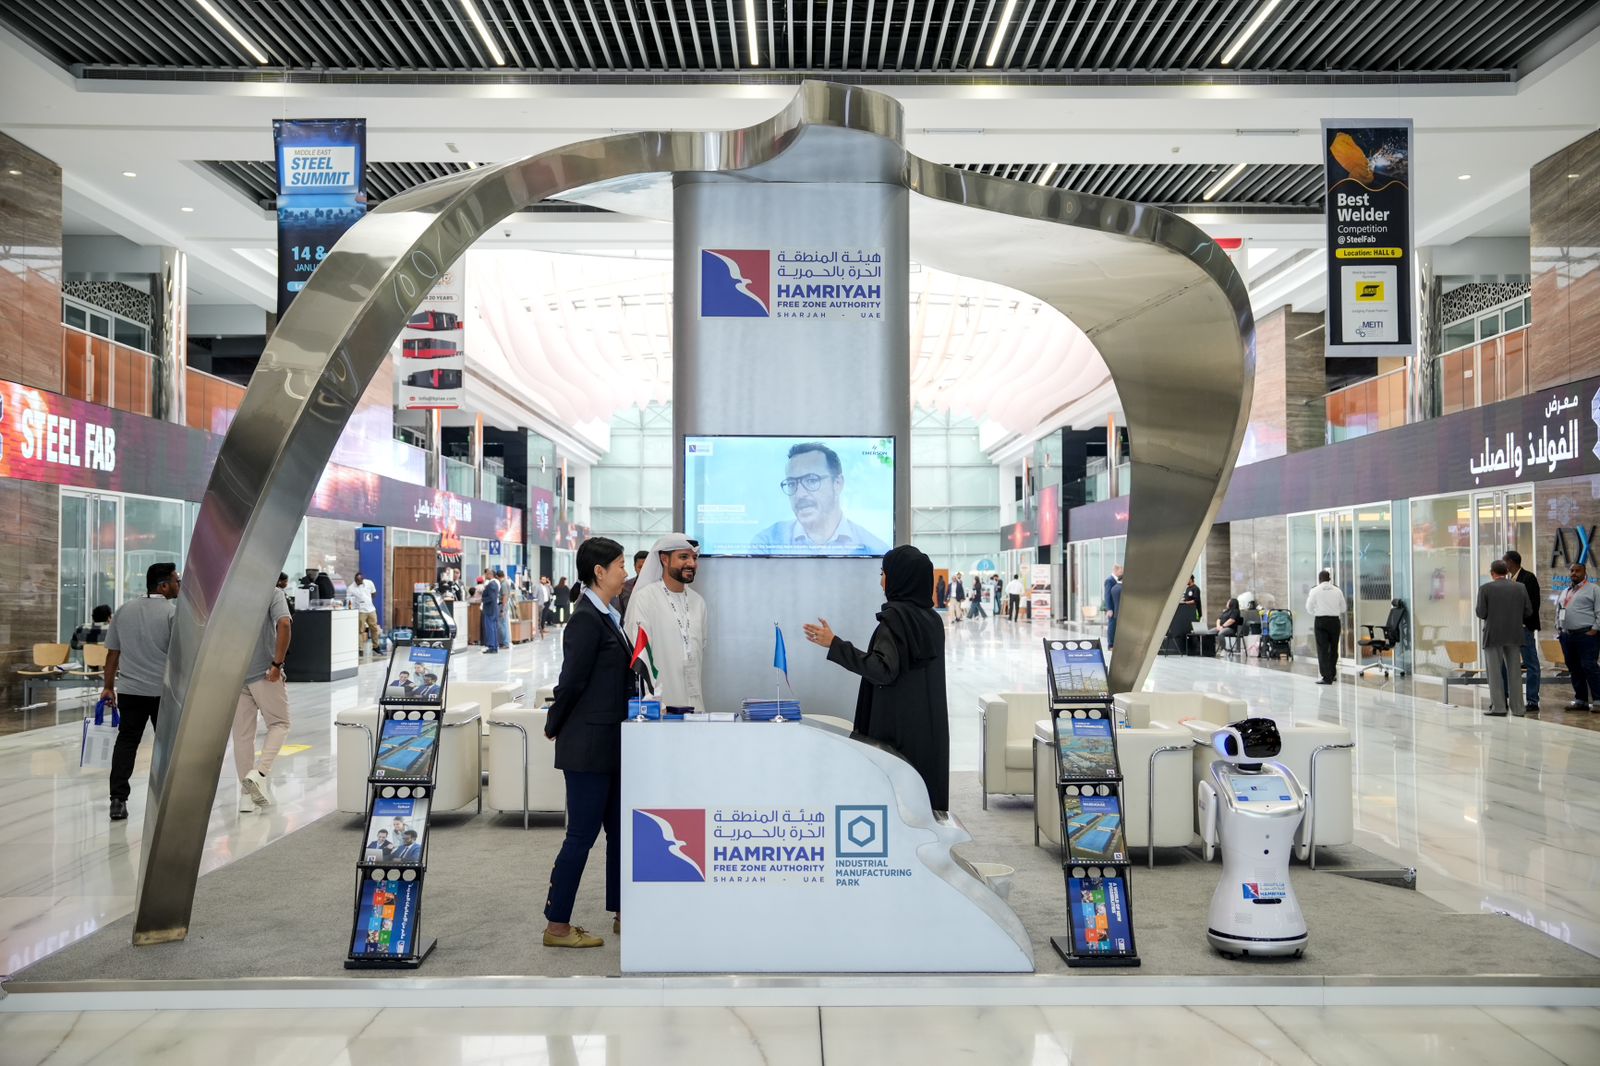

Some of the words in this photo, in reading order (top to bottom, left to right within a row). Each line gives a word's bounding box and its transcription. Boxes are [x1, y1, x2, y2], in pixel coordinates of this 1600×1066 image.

[291, 157, 333, 170] STEEL
[291, 172, 350, 185] SUMMIT
[1337, 193, 1370, 206] Best
[1337, 207, 1390, 222] Welder
[1337, 224, 1388, 234] Competition
[1338, 236, 1345, 244] @
[1346, 235, 1376, 243] SteelFab
[291, 246, 311, 260] 14
[315, 245, 328, 260] &
[777, 251, 837, 263] المنطقة
[842, 250, 881, 265] هيئة
[294, 264, 318, 272] JANU
[777, 265, 844, 280] بالحمرية
[849, 265, 881, 279] الحرة
[777, 284, 880, 298] HAMRIYAH
[1545, 394, 1578, 418] معرض
[21, 408, 80, 467] STEEL
[85, 422, 116, 472] FAB
[1527, 419, 1579, 473] الفولاذ
[1470, 432, 1522, 484] والصلب
[714, 810, 778, 823] المنطقة
[782, 809, 824, 826] هيئة
[714, 826, 784, 841] بالحمرية
[790, 826, 824, 841] الحرة
[714, 846, 824, 861] HAMRIYAH
